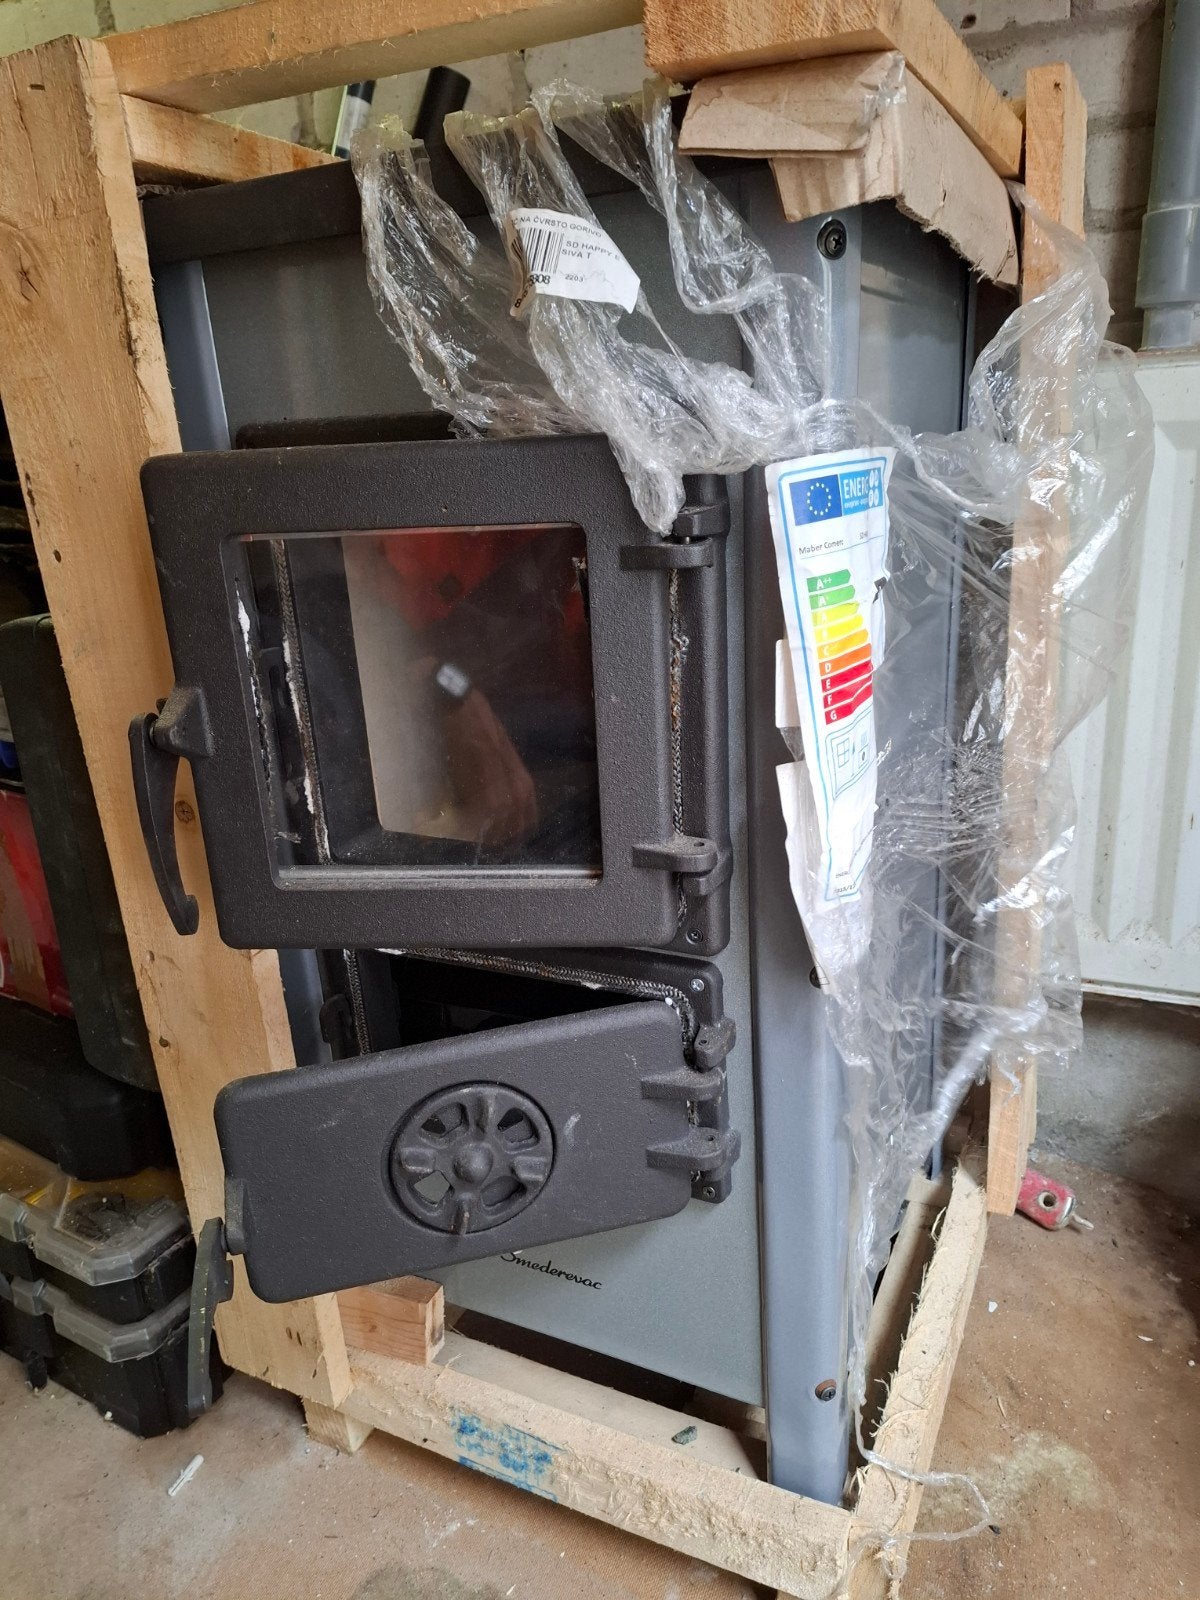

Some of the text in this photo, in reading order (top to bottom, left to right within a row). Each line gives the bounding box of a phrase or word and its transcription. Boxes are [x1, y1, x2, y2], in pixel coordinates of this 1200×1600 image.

[533, 215, 568, 229] ČVRSTO
[569, 223, 602, 238] GORIVO
[566, 240, 579, 248] SD
[581, 243, 613, 257] HAPPY
[561, 249, 583, 259] SIVA
[798, 543, 823, 555] Maber
[825, 663, 832, 671] D
[825, 679, 831, 689] E
[827, 695, 833, 705] F
[830, 710, 837, 720] G
